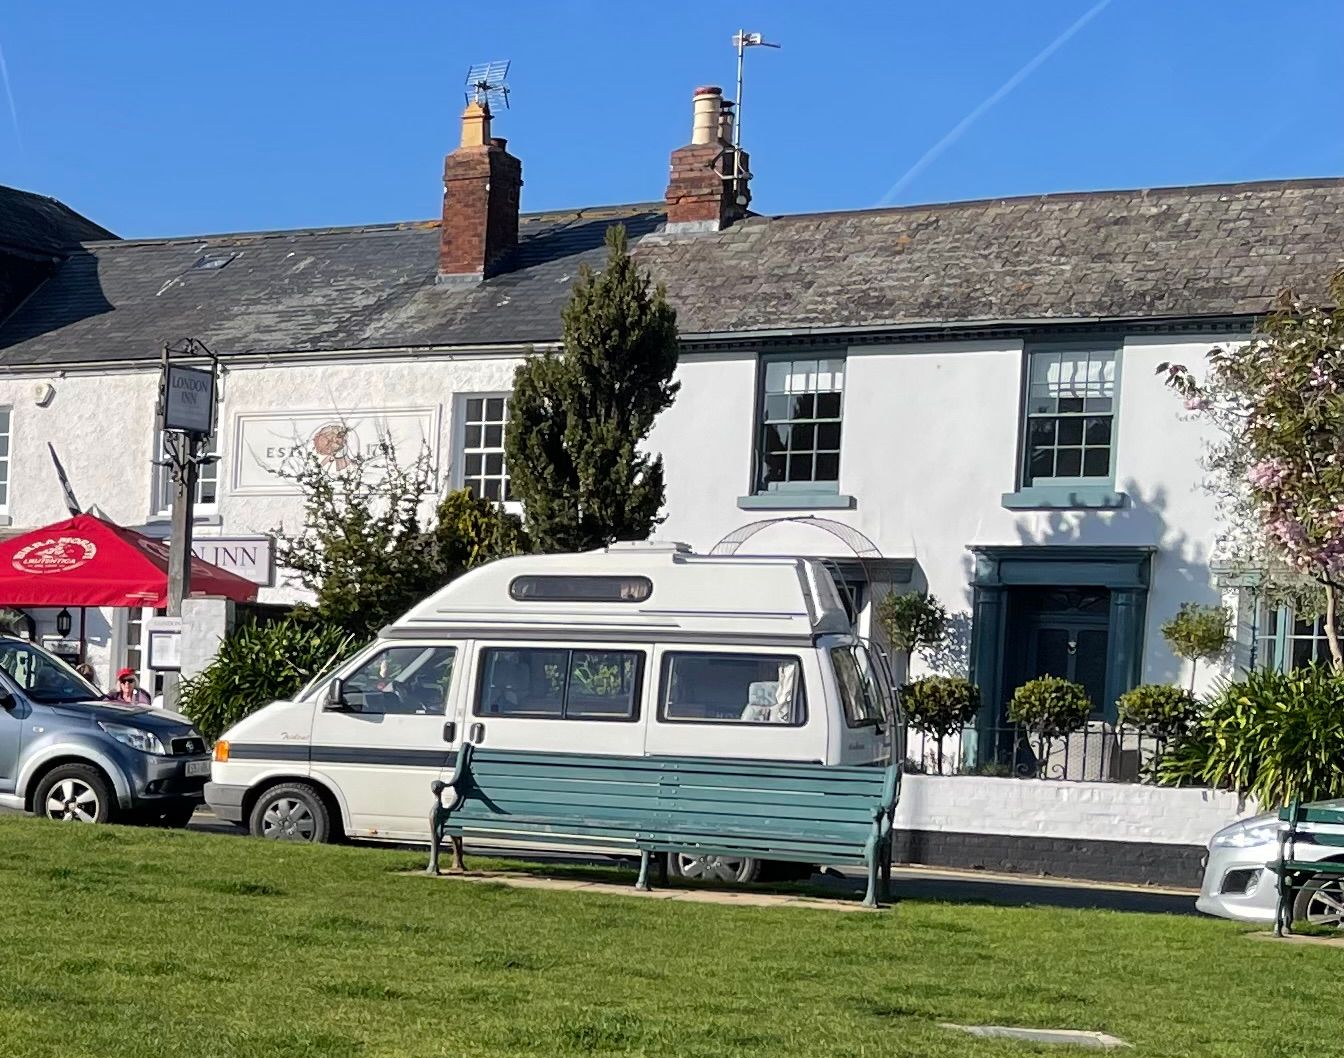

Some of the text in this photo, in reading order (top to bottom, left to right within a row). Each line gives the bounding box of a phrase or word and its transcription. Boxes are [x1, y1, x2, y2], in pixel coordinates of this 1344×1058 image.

[172, 376, 209, 392] LONDON
[181, 391, 199, 404] INN
[214, 546, 258, 567] INN
